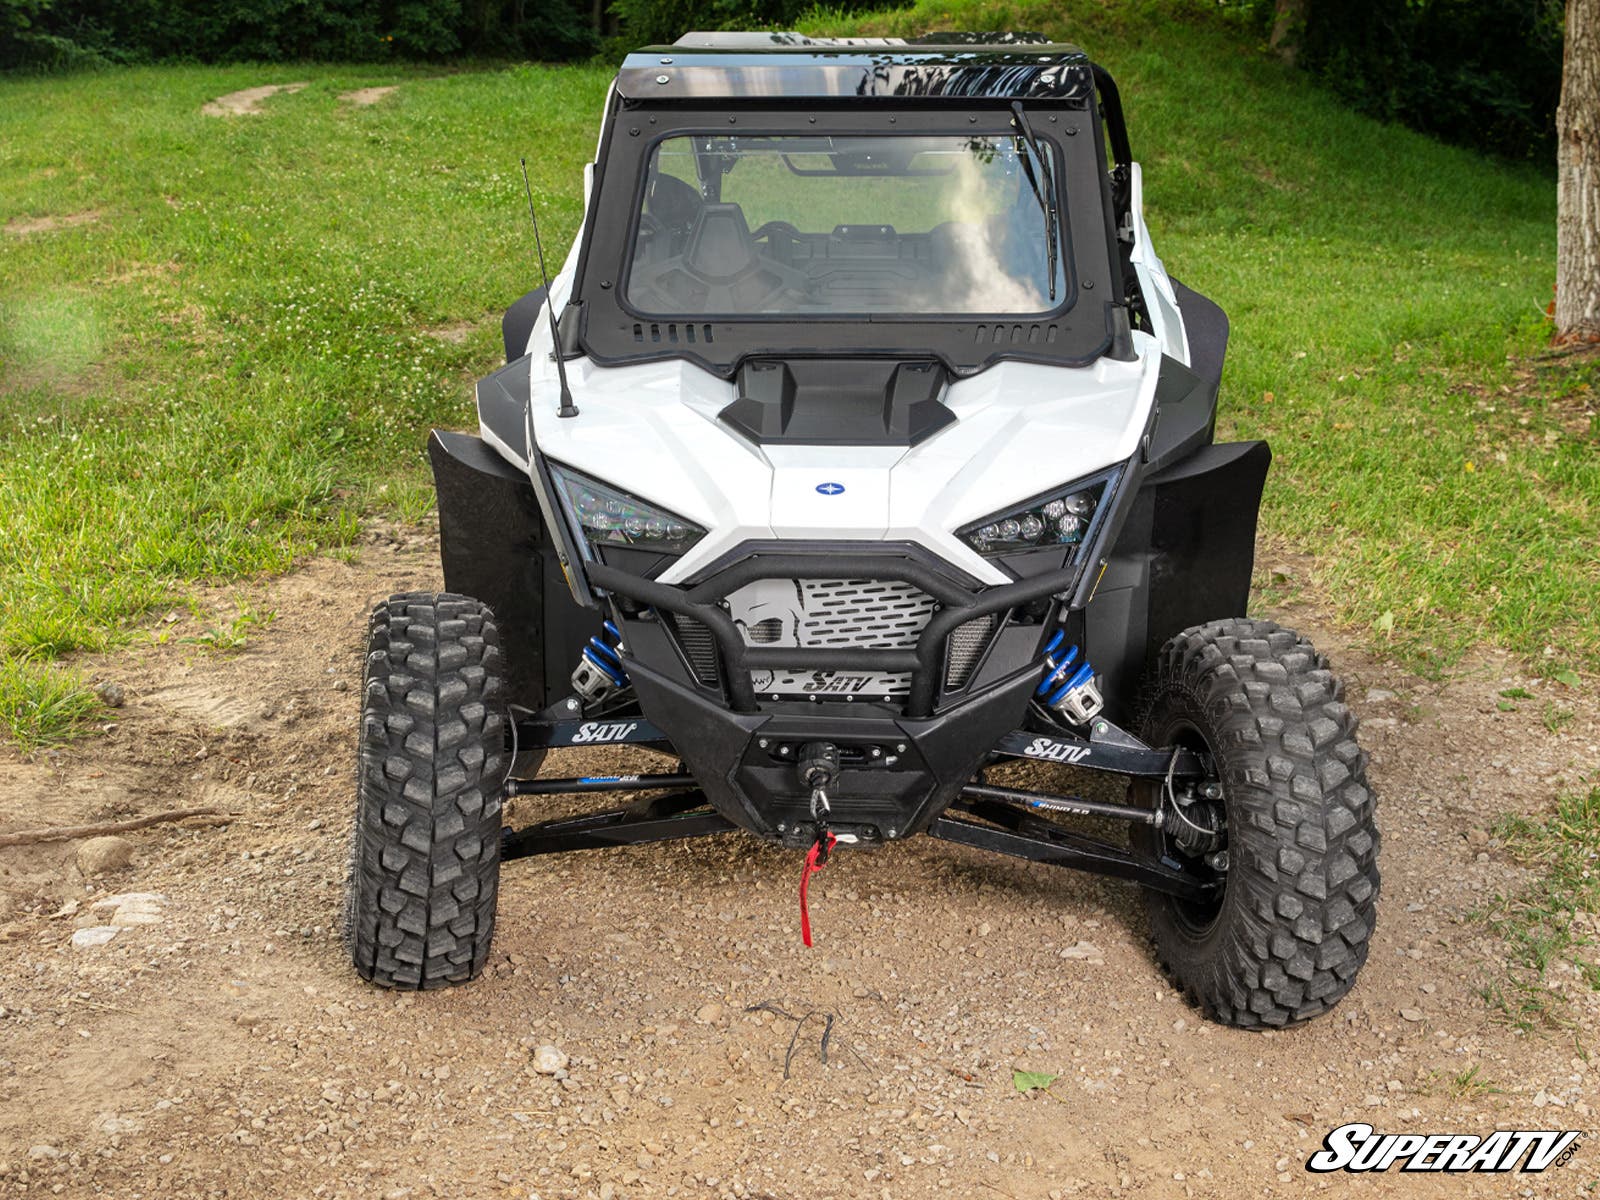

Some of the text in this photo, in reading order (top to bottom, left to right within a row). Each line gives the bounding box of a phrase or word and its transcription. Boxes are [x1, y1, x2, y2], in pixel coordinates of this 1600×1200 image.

[802, 670, 873, 693] SATV
[571, 721, 638, 743] SATV
[1023, 737, 1092, 763] SATV
